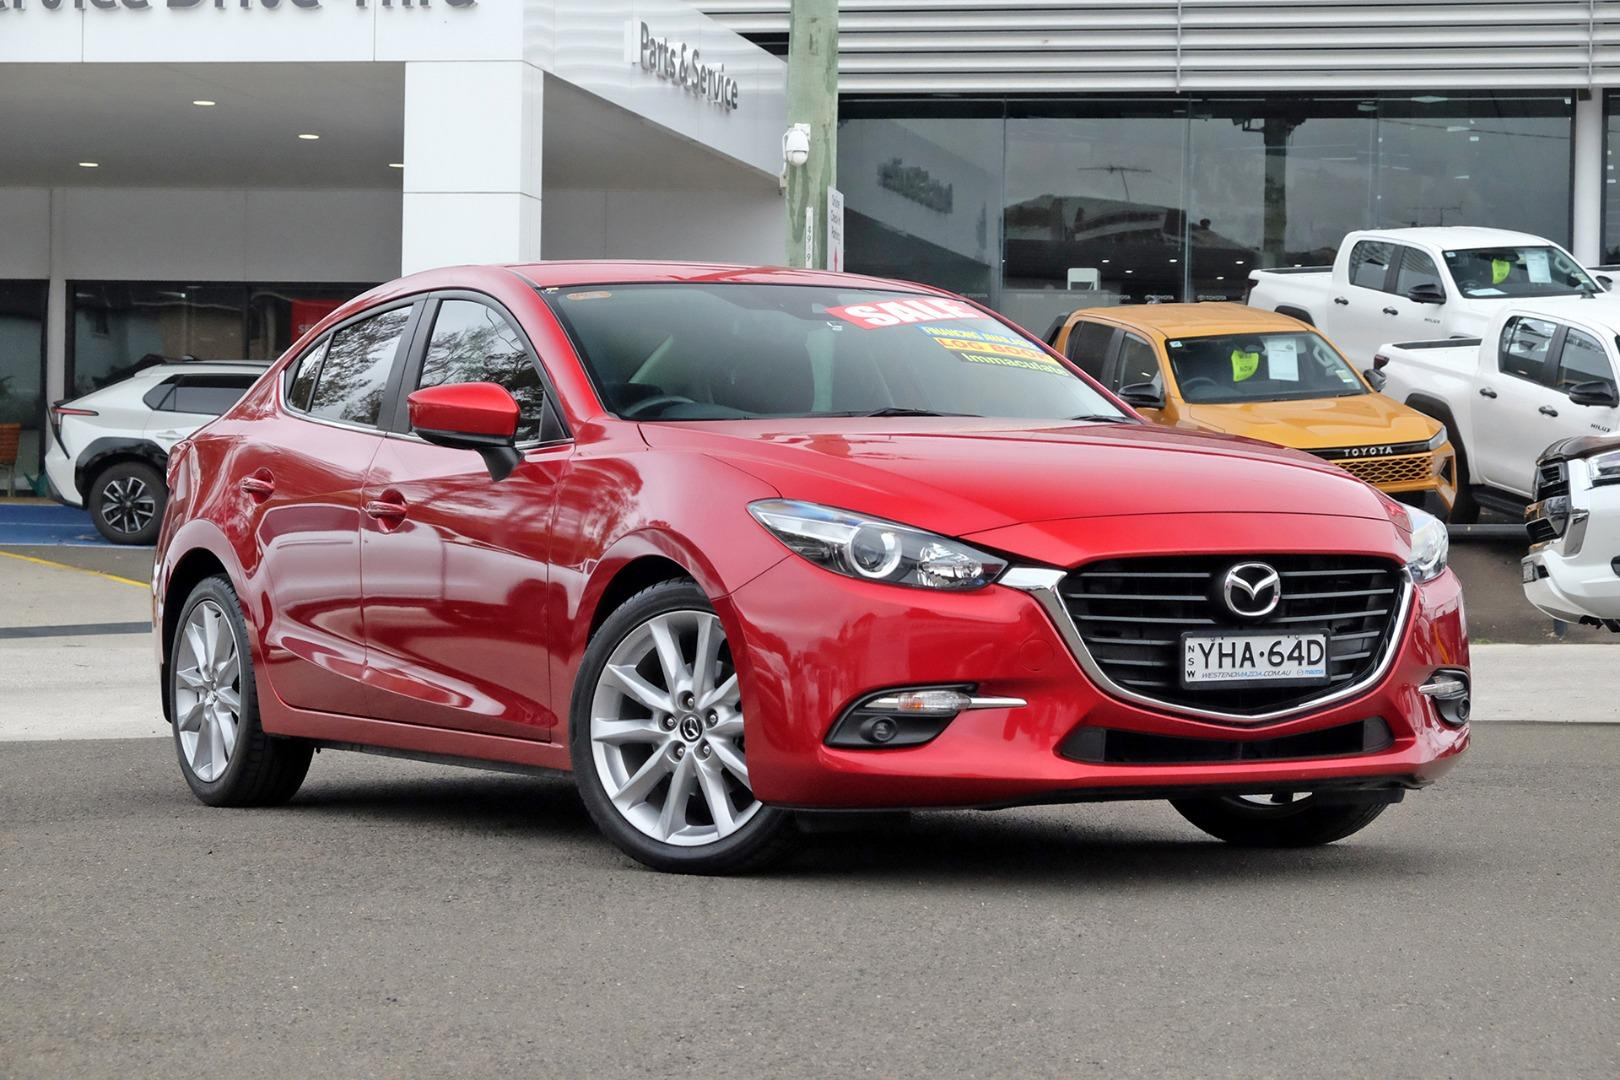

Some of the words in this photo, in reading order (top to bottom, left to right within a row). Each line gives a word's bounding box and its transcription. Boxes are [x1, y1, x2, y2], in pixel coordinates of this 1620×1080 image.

[641, 21, 676, 80] Parts
[680, 43, 689, 85] &
[692, 49, 738, 110] Service
[844, 299, 979, 326] SALE
[1344, 446, 1393, 457] TOYOTA
